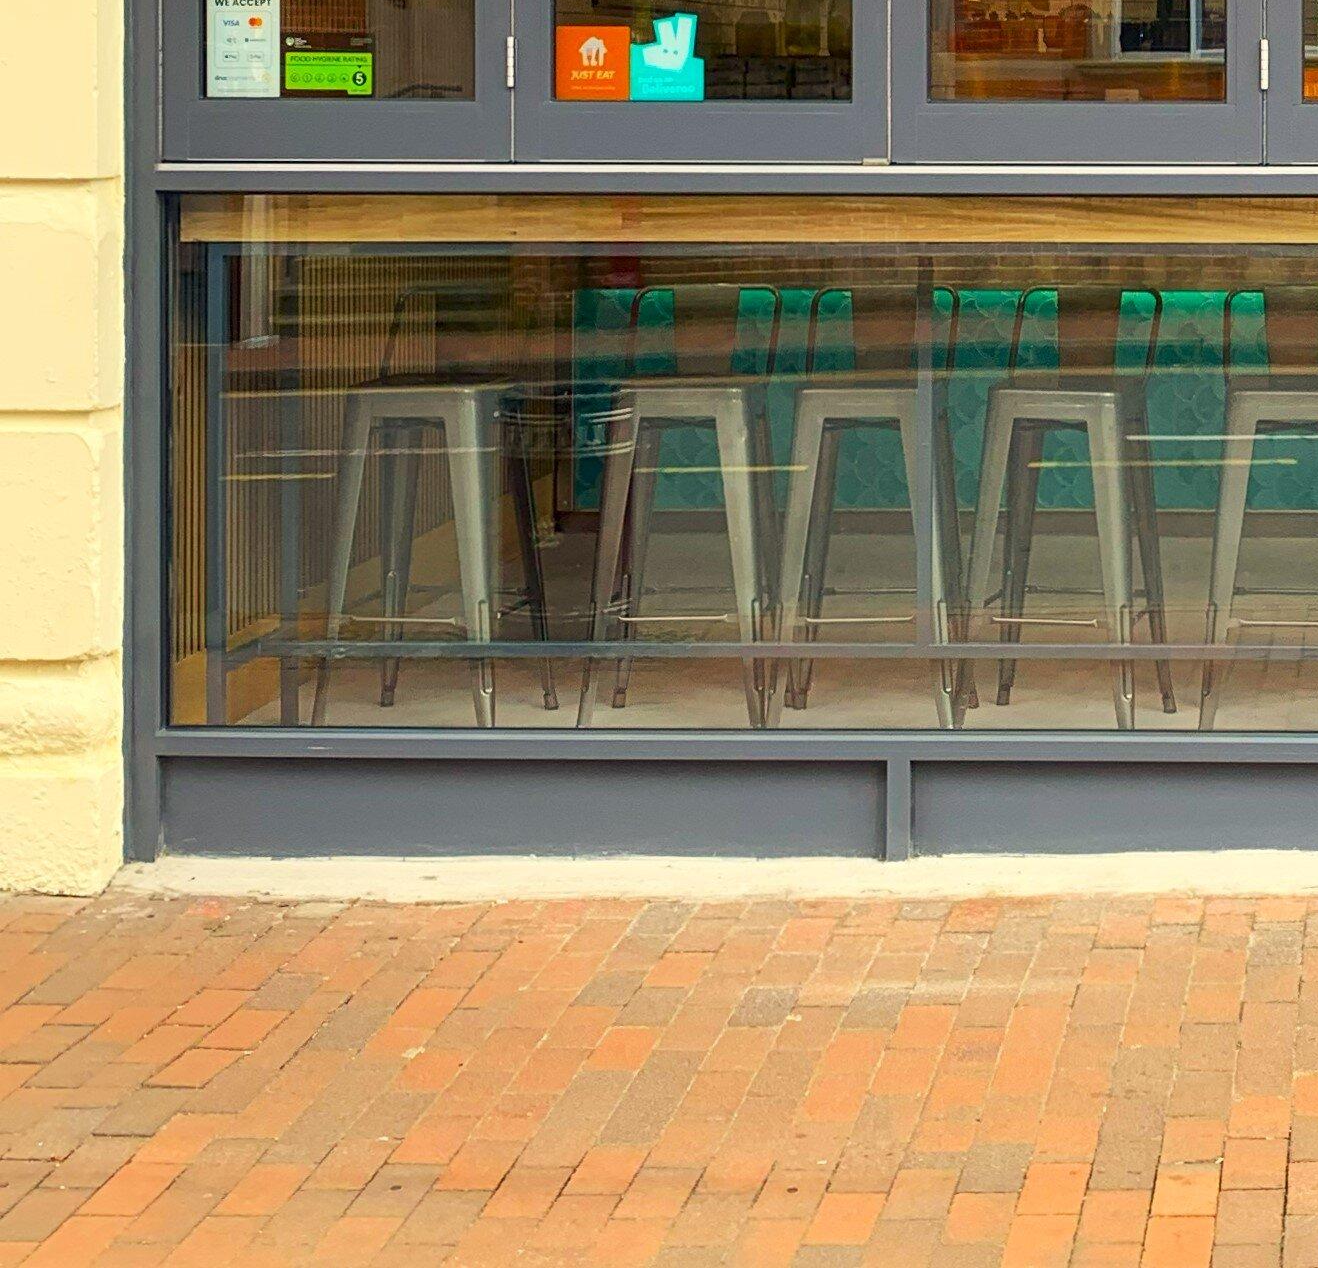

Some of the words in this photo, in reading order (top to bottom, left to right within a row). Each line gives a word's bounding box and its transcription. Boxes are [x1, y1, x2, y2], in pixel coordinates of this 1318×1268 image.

[355, 72, 364, 85] 5
[570, 70, 595, 81] JUST
[596, 70, 616, 80] EAT
